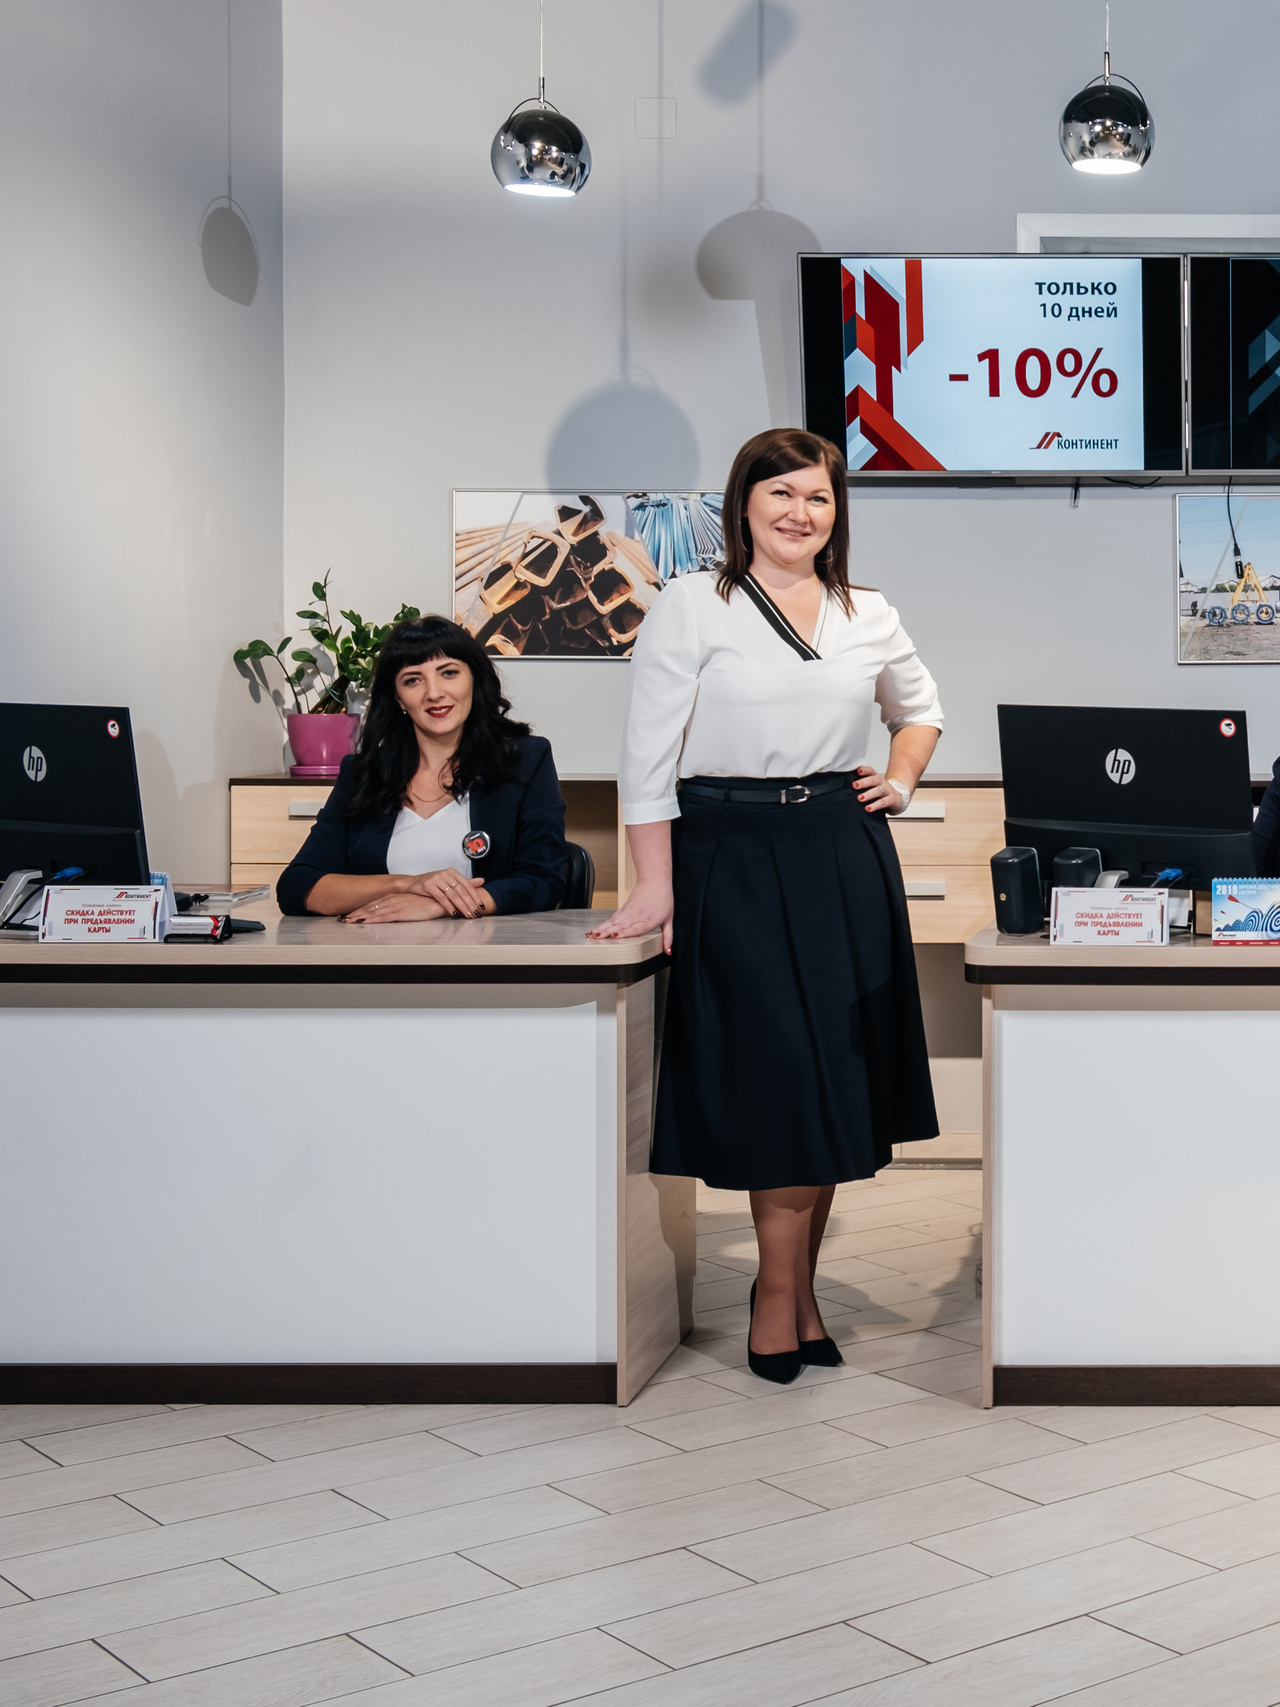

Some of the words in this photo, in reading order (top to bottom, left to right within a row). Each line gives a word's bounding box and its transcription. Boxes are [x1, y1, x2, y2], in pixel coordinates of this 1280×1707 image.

[1039, 302, 1062, 318] 10
[1067, 302, 1118, 322] дней
[948, 347, 1118, 398] -10%
[1057, 437, 1119, 450] КОНТИНЕНТ
[26, 746, 45, 782] hp
[1108, 749, 1133, 784] hp
[65, 909, 95, 917] СКИДКА
[97, 908, 136, 917] ДЕЙСТВУЕТ
[1106, 911, 1143, 920] ДЕЙСТВУЕТ
[80, 918, 136, 926] ПРЕДЪЯВЛЕНИИ
